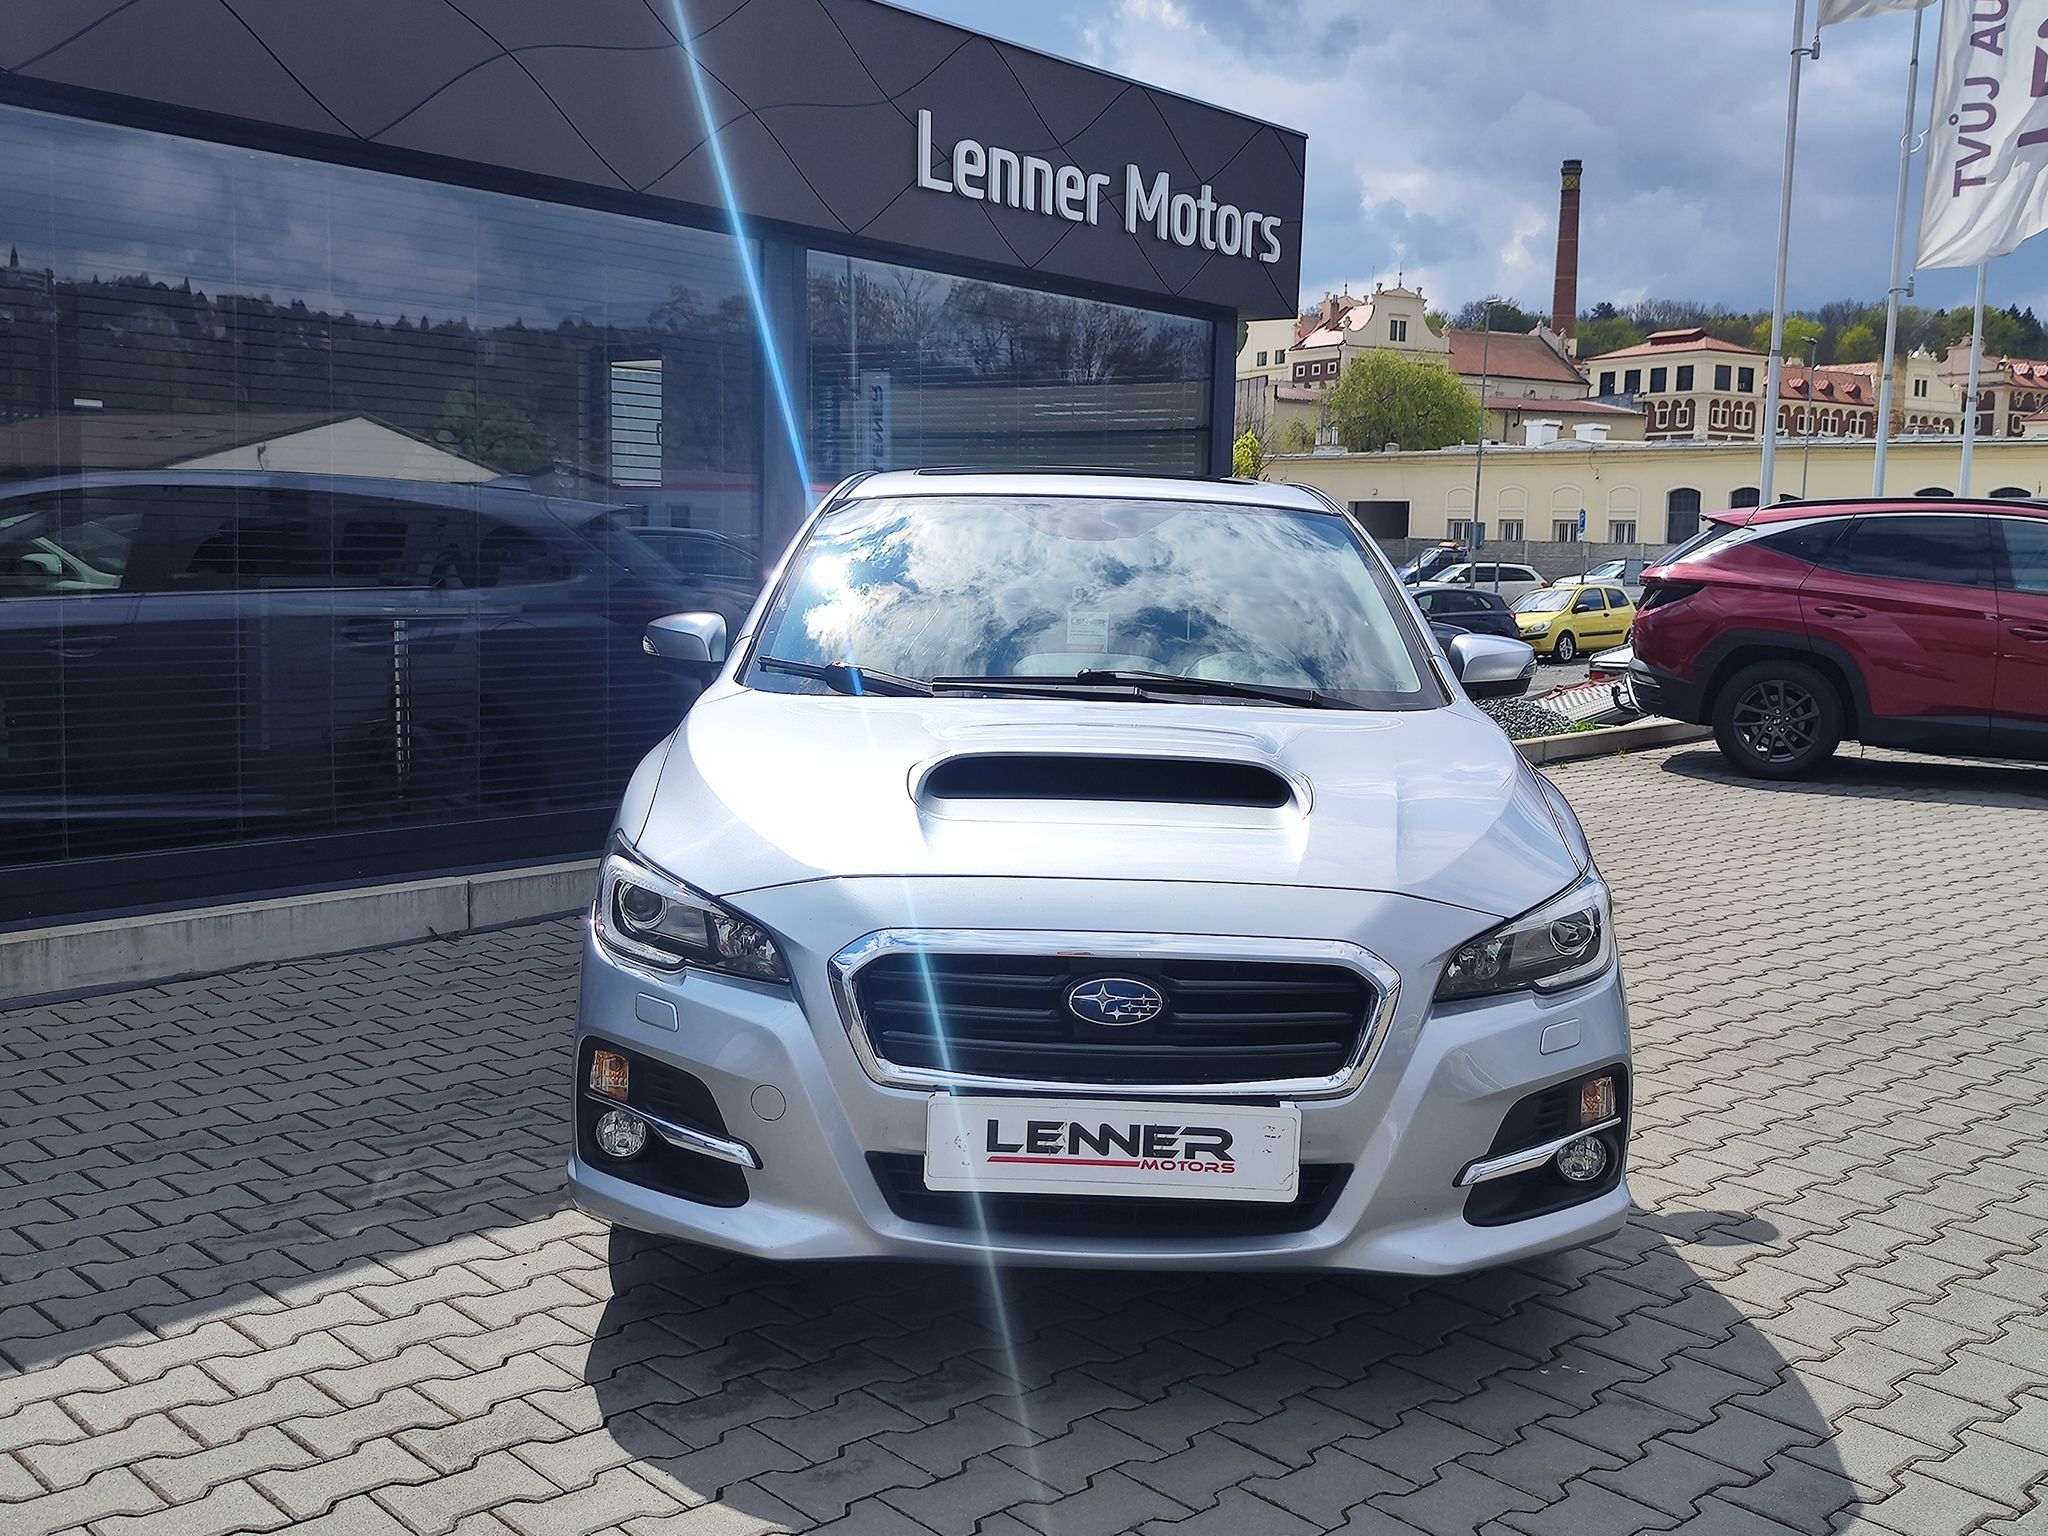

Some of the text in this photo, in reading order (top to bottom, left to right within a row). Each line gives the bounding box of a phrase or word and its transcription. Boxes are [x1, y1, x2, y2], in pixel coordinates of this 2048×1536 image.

[1948, 76, 2000, 198] TVŮJ
[916, 108, 1283, 265] Lenner Motors
[985, 1118, 1236, 1162] LENNER
[1139, 1159, 1236, 1174] MOTORS
